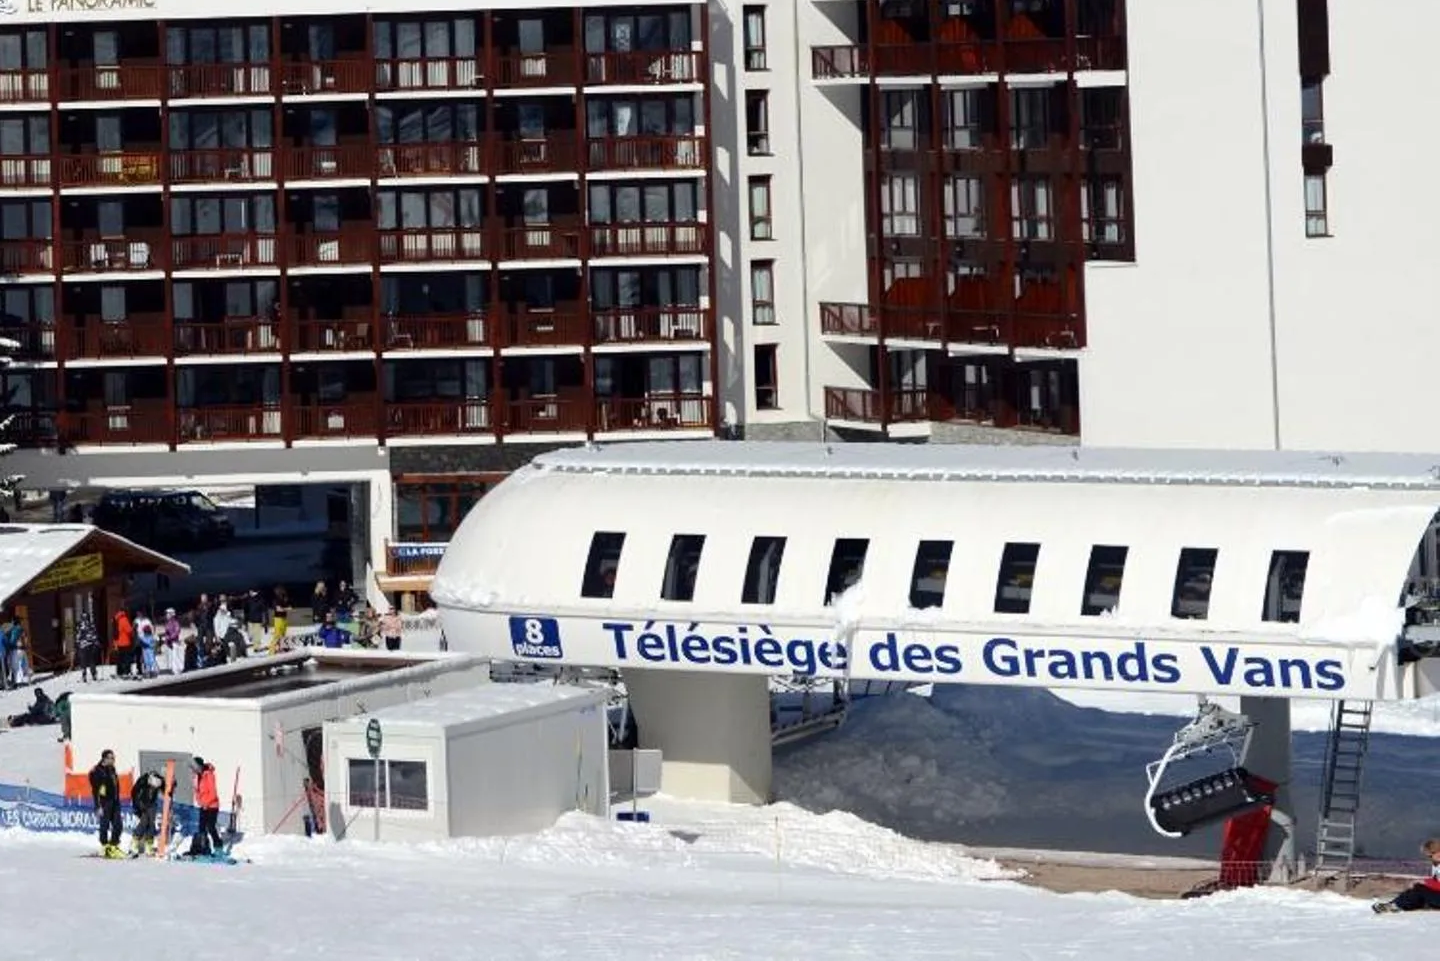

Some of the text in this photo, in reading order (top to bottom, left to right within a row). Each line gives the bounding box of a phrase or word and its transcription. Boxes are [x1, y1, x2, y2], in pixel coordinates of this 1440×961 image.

[524, 618, 545, 645] 8
[515, 641, 561, 657] places
[602, 619, 1346, 691] Télésiège des Grands Vans
